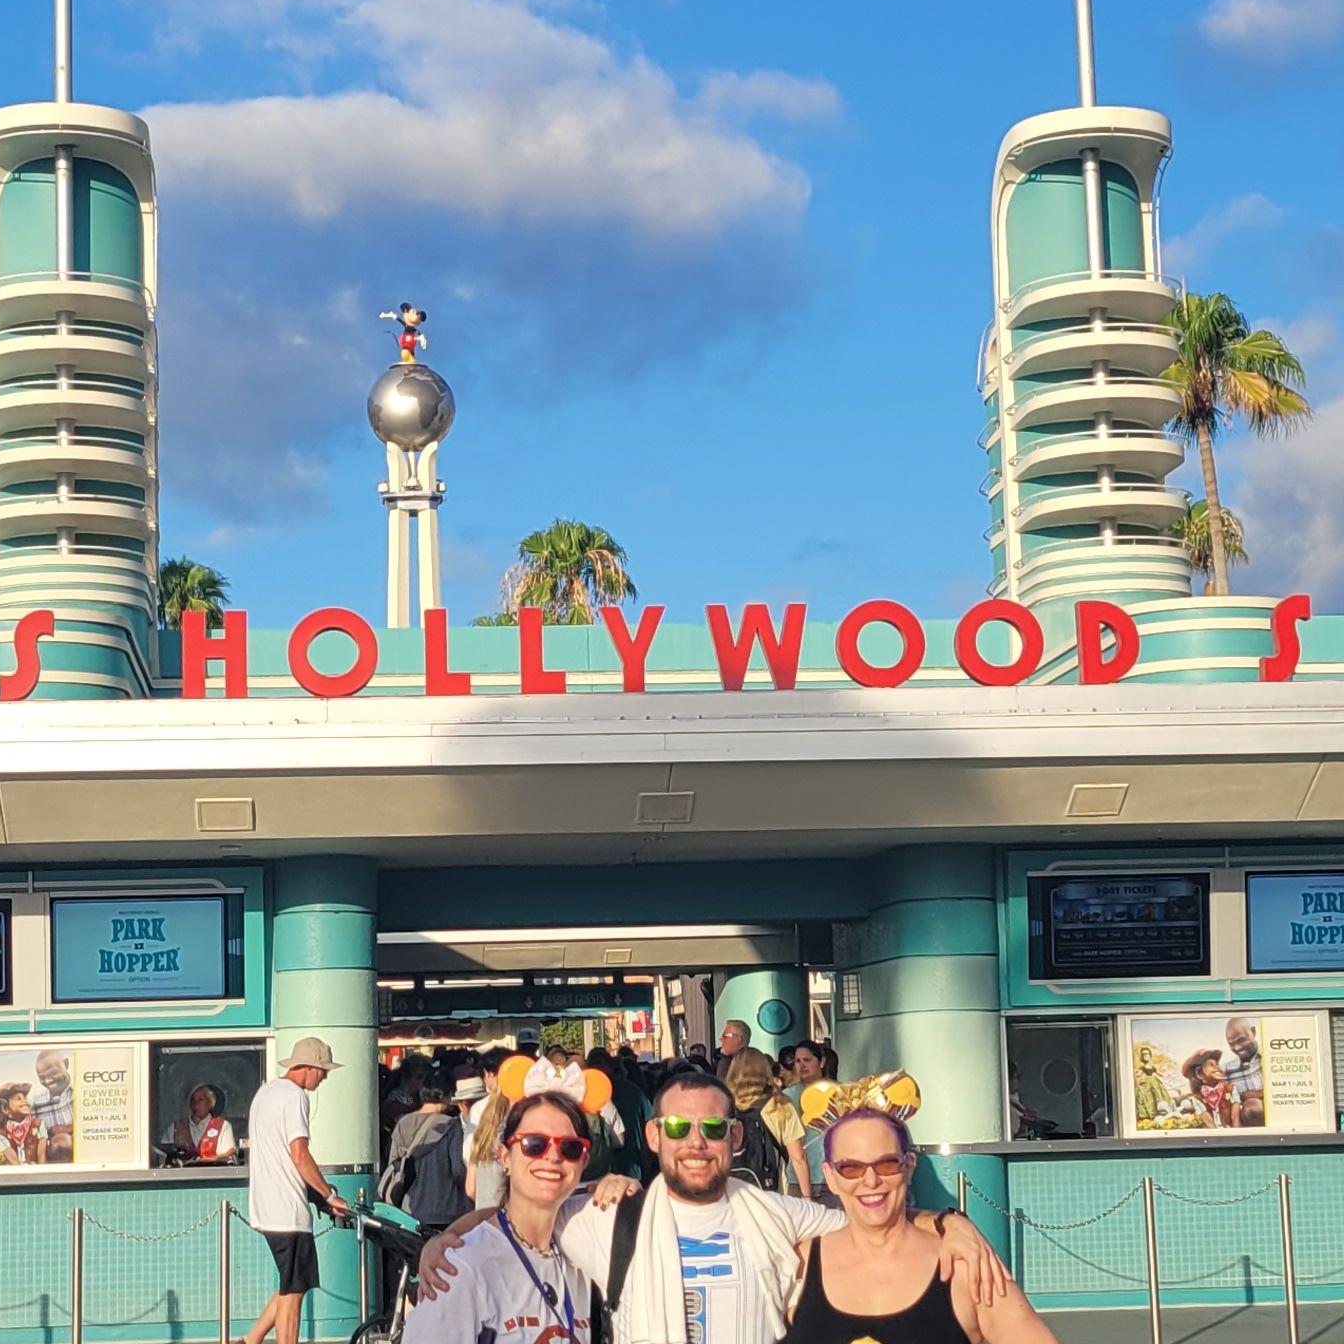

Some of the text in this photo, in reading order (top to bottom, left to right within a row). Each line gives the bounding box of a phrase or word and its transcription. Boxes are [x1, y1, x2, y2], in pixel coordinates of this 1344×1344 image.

[181, 598, 1140, 698] HOLLYWOOD
[111, 917, 166, 943] PARK
[99, 945, 181, 973] HOPPER
[1270, 1038, 1311, 1050] EPCOT
[1270, 1064, 1312, 1073] GARDEN
[83, 1070, 127, 1083] EPCOT
[83, 1088, 120, 1097] FLOWER
[83, 1097, 127, 1107] GARDEN
